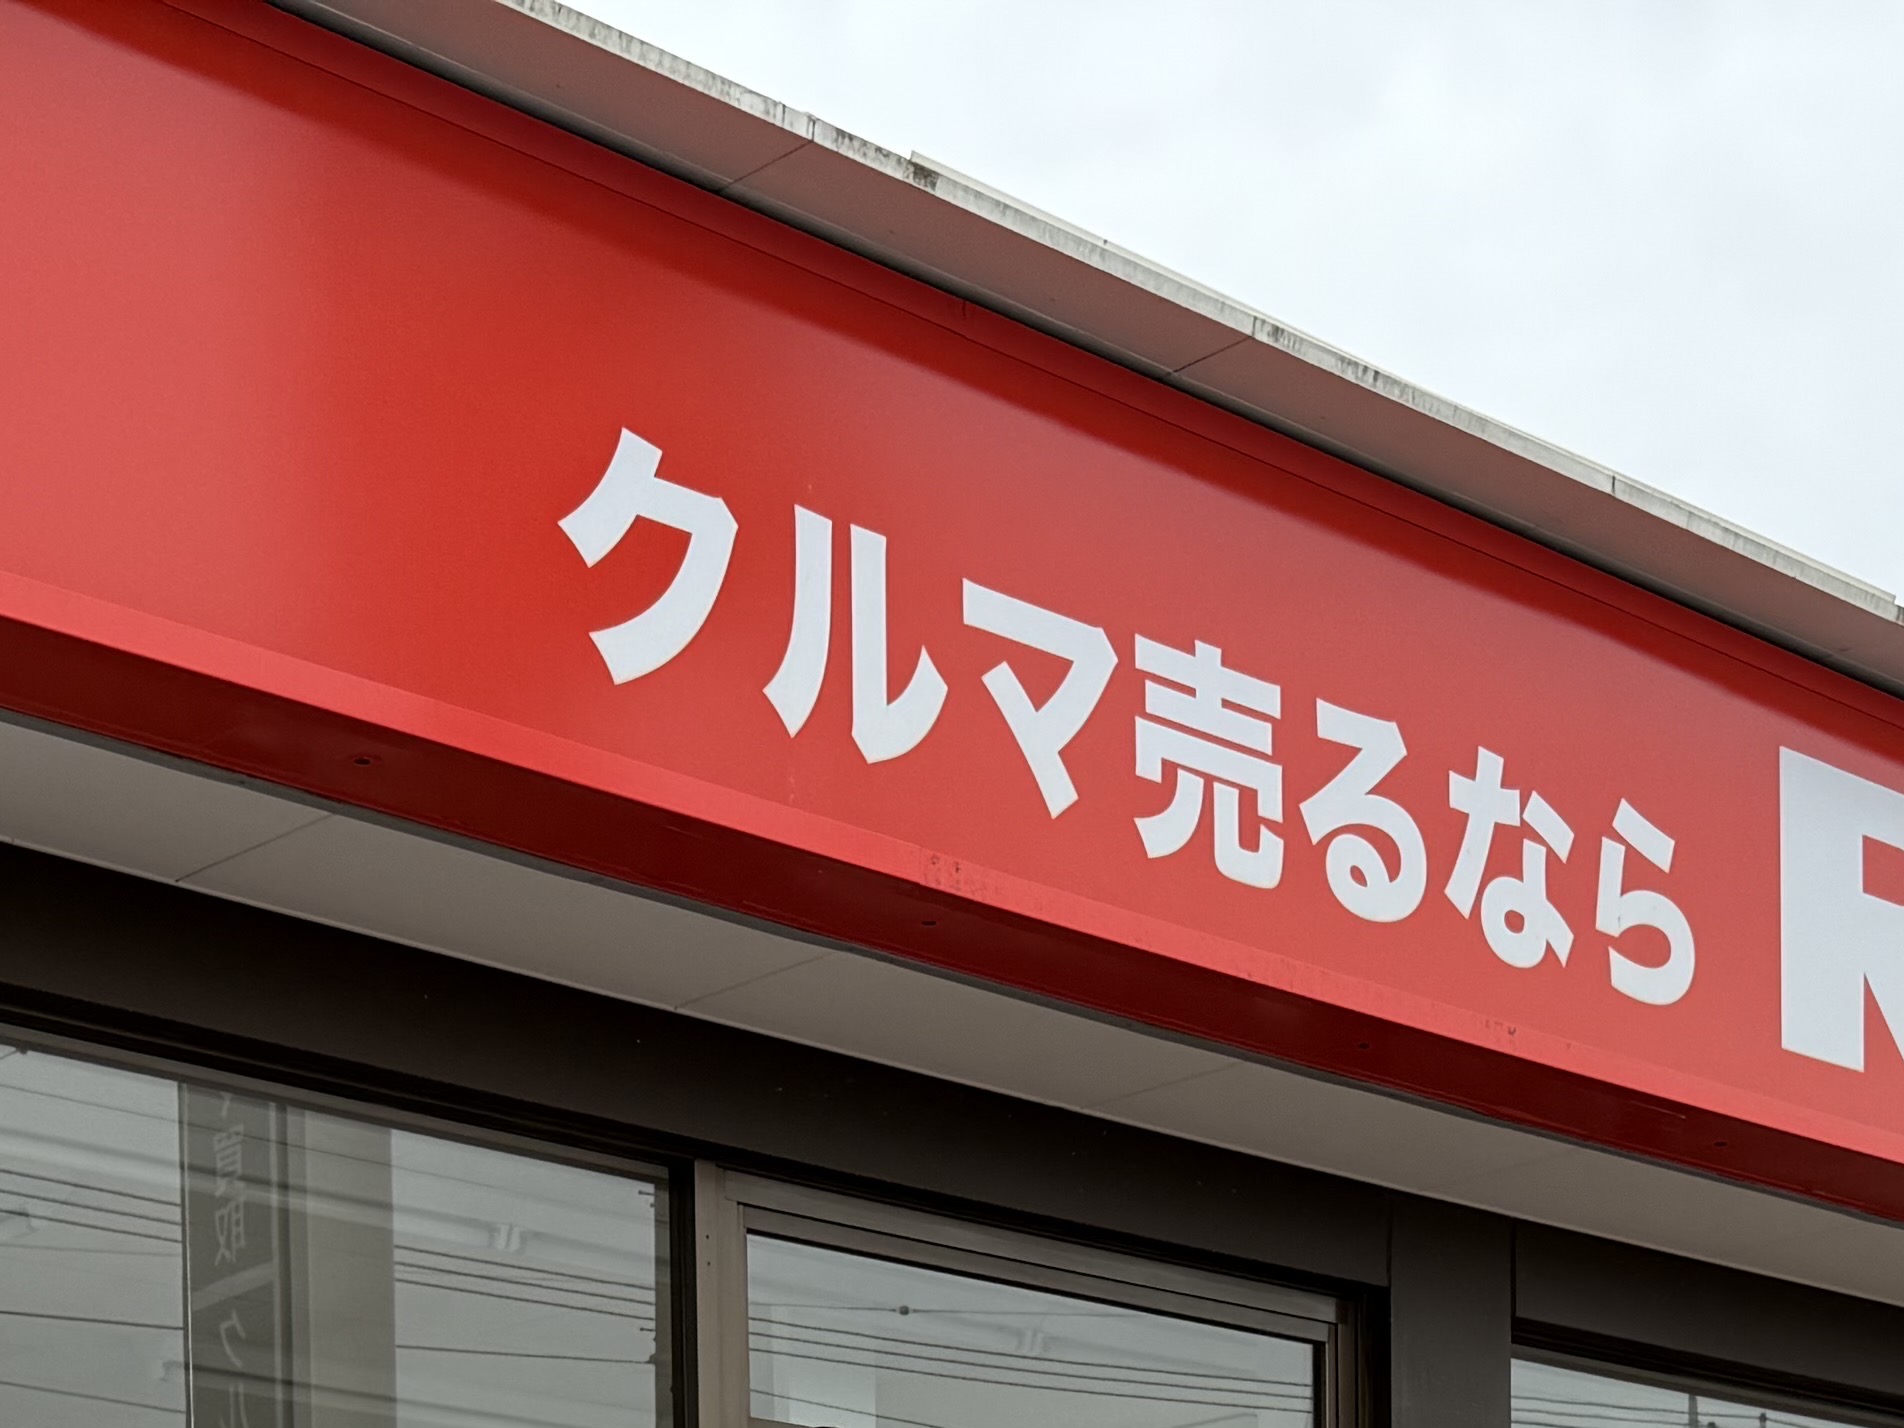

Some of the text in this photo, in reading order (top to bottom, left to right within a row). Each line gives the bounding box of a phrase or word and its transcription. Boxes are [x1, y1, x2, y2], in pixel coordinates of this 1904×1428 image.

[558, 427, 1697, 1005] クルマ売るなら
